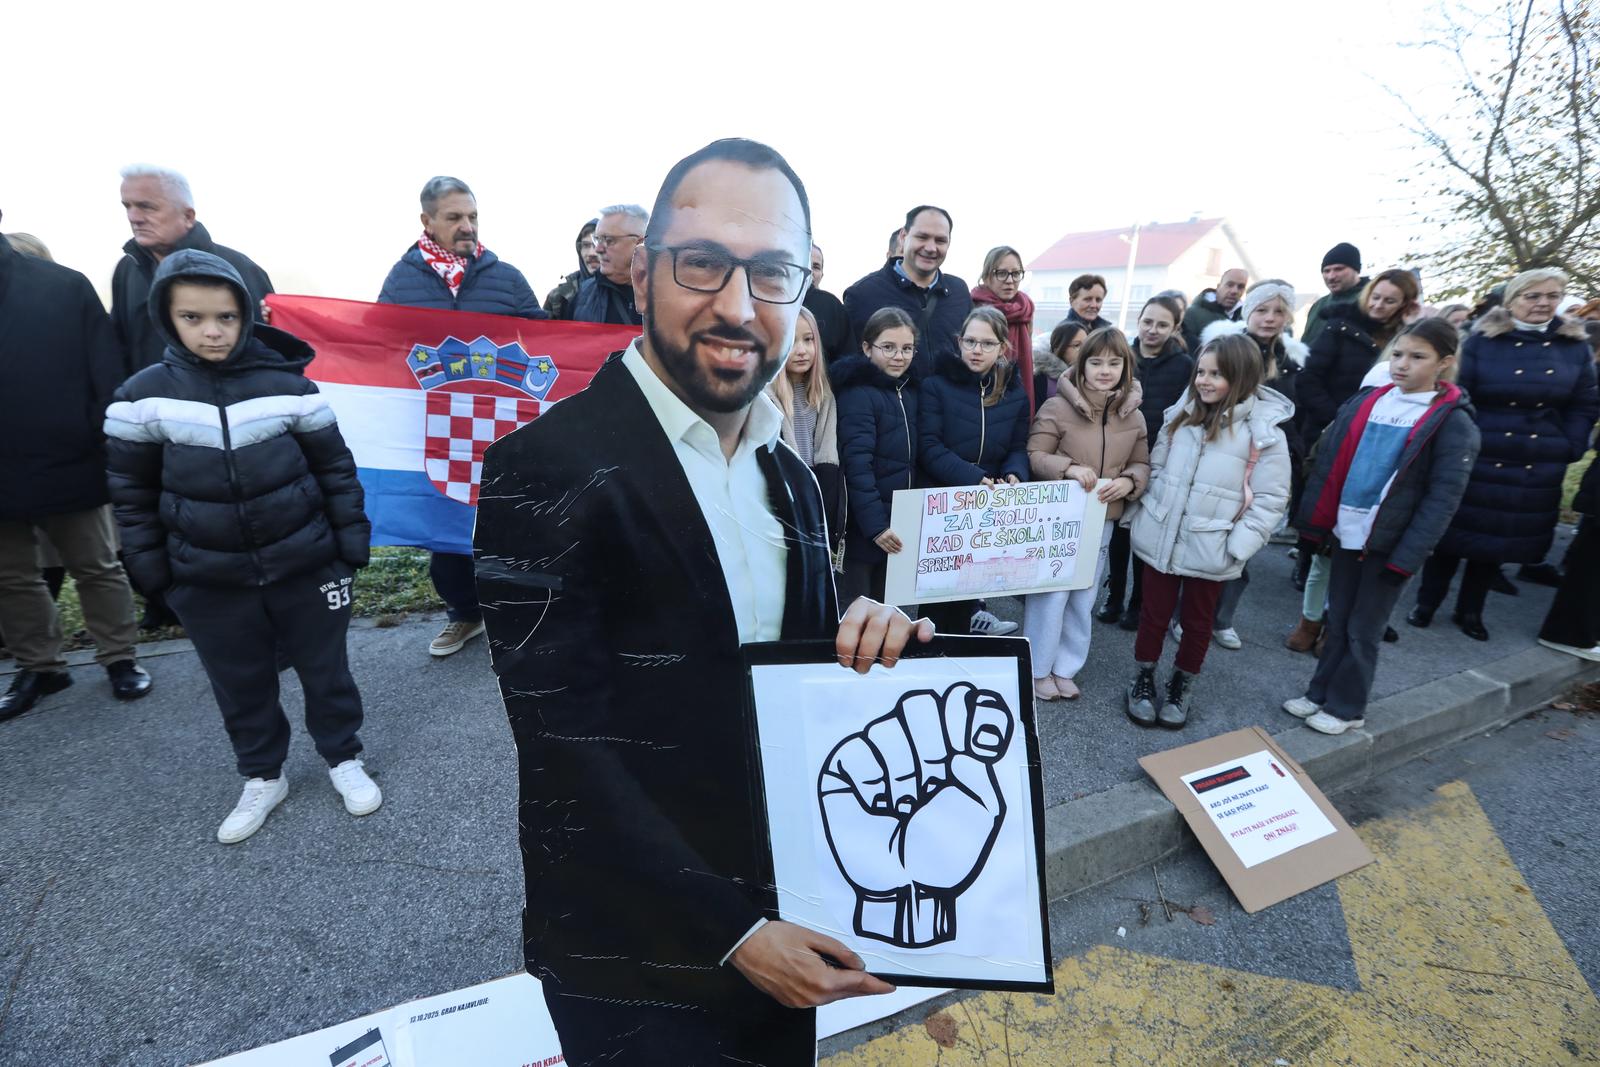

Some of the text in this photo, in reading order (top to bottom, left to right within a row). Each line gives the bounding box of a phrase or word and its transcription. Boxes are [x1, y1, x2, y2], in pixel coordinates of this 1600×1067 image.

[927, 483, 1070, 515] MI SMO SPREMNI
[944, 513, 974, 533] ZA
[926, 520, 1081, 554] KAD ĆE ŠKOLA BITI
[917, 542, 1077, 575] SPREMNA ZA NAS
[1050, 559, 1063, 578] ?
[327, 585, 351, 610] 93
[1263, 831, 1276, 841] ONI
[440, 1005, 456, 1016] GRAD
